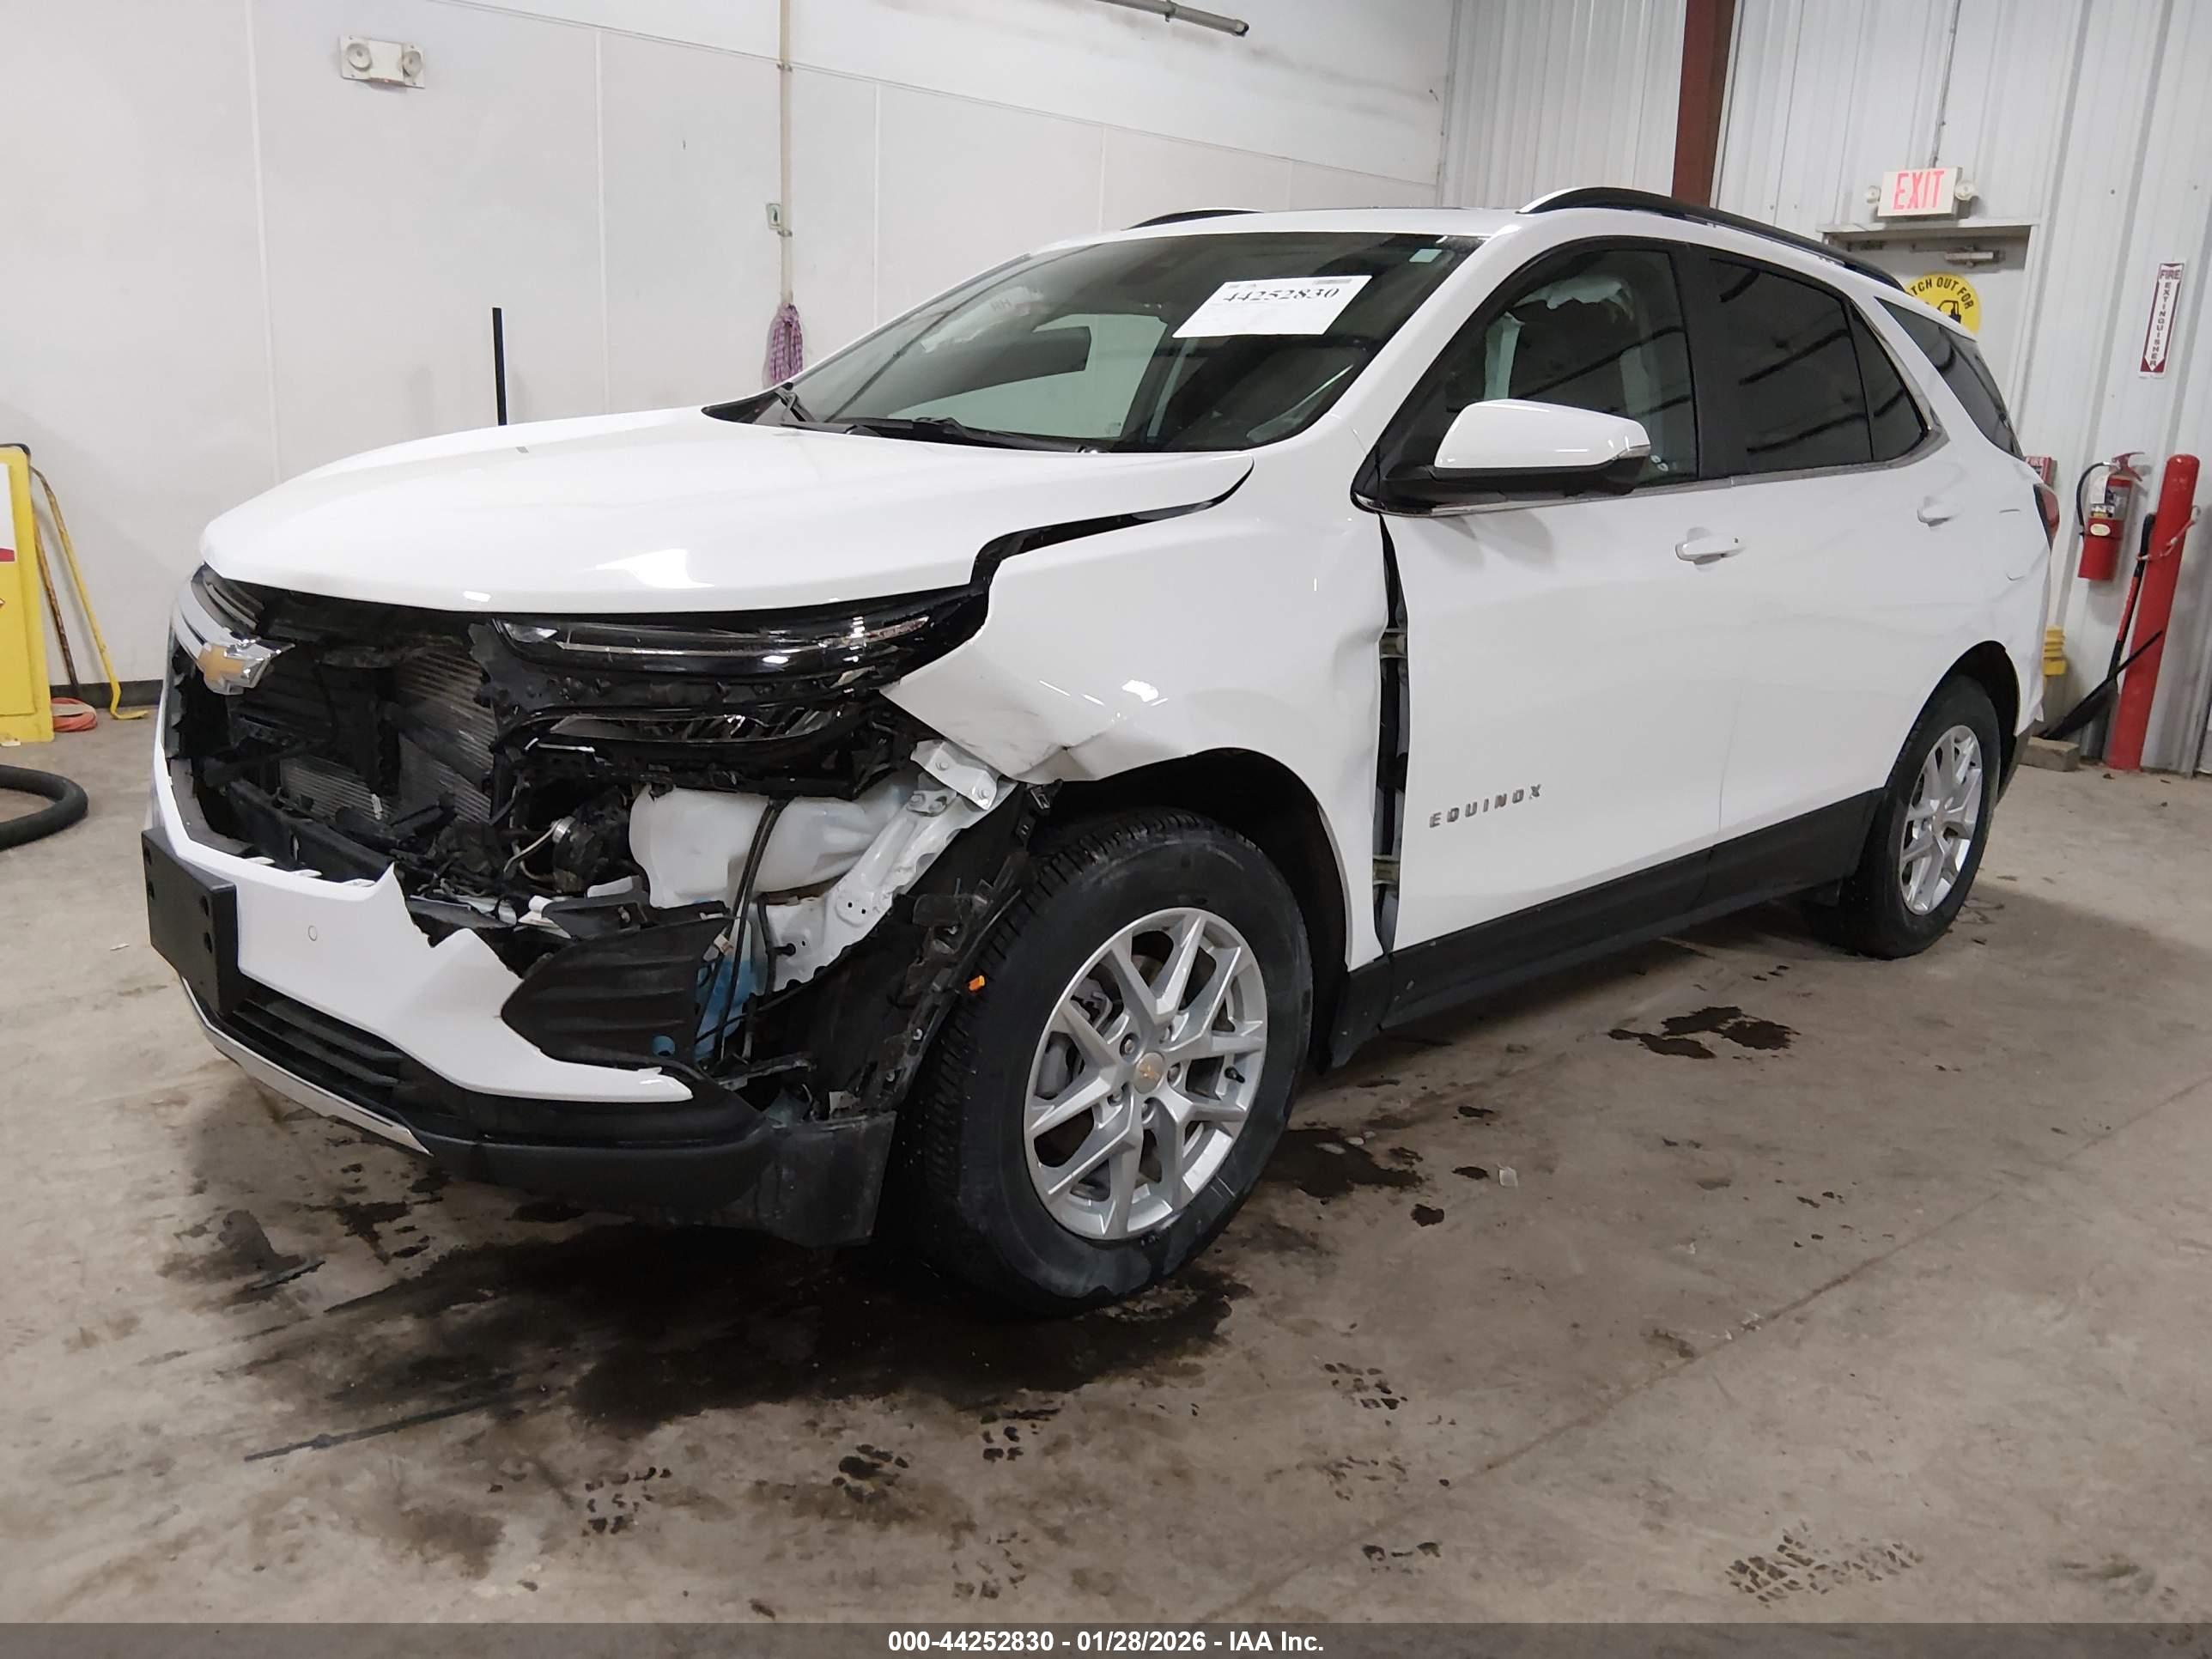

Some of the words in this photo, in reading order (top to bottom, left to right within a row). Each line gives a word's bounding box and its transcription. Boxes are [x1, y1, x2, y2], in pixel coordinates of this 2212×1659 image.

[1893, 170, 1945, 210] EXIT
[1936, 276, 1959, 291] OUT
[1957, 287, 1974, 309] FOR
[2160, 270, 2181, 280] FIRE
[1224, 288, 1340, 302] 44252830
[2149, 282, 2171, 367] EXTINGUISHER
[1429, 784, 1541, 829] EQUINOX
